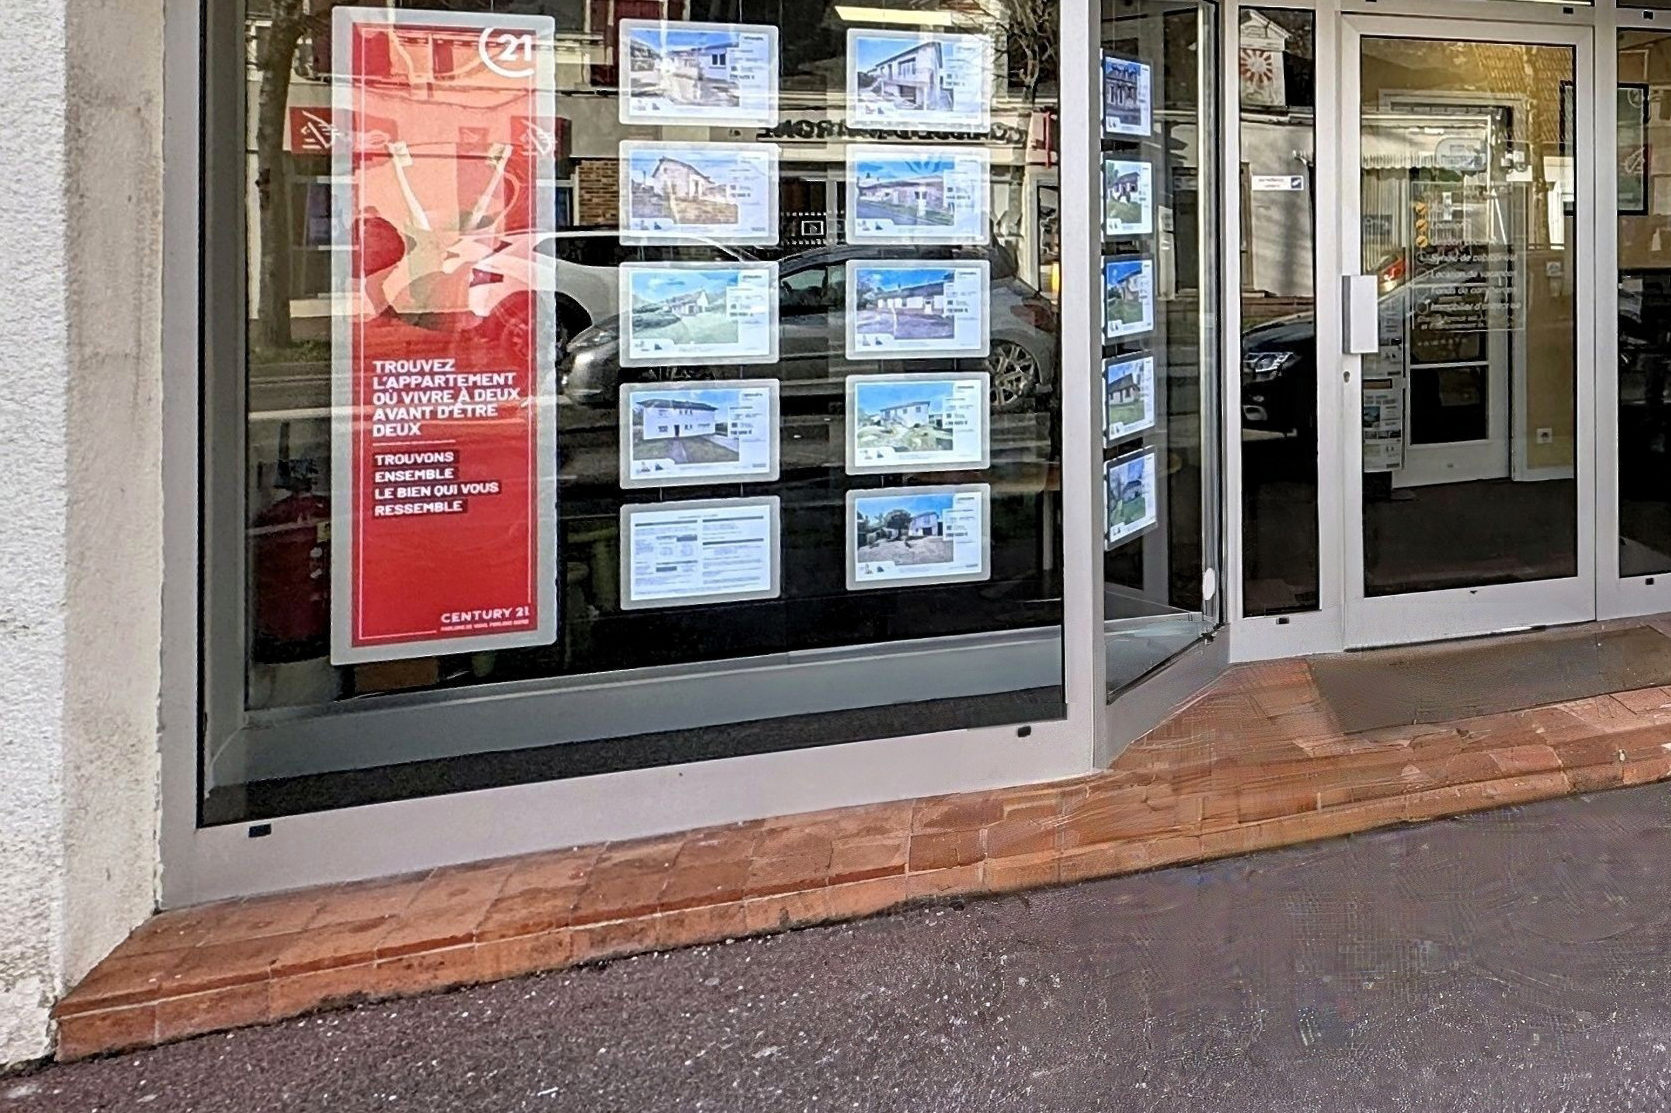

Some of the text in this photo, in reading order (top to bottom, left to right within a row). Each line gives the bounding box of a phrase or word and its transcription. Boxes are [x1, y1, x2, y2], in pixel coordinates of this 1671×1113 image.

[372, 359, 455, 374] TROUVEZ
[373, 373, 516, 389] L'APPARTEMENT
[373, 387, 520, 405] OÙ VIVRE À DEUX
[373, 402, 498, 421] AVANT D'ÊTRE
[373, 422, 421, 437] DEUX
[375, 451, 454, 466] TROUVONS
[375, 468, 454, 483] ENSEMBLE
[375, 482, 499, 500] LE BIEN QUI VOUS
[375, 500, 463, 516] RESSEMBLE
[441, 606, 530, 623] CENTURY 21
